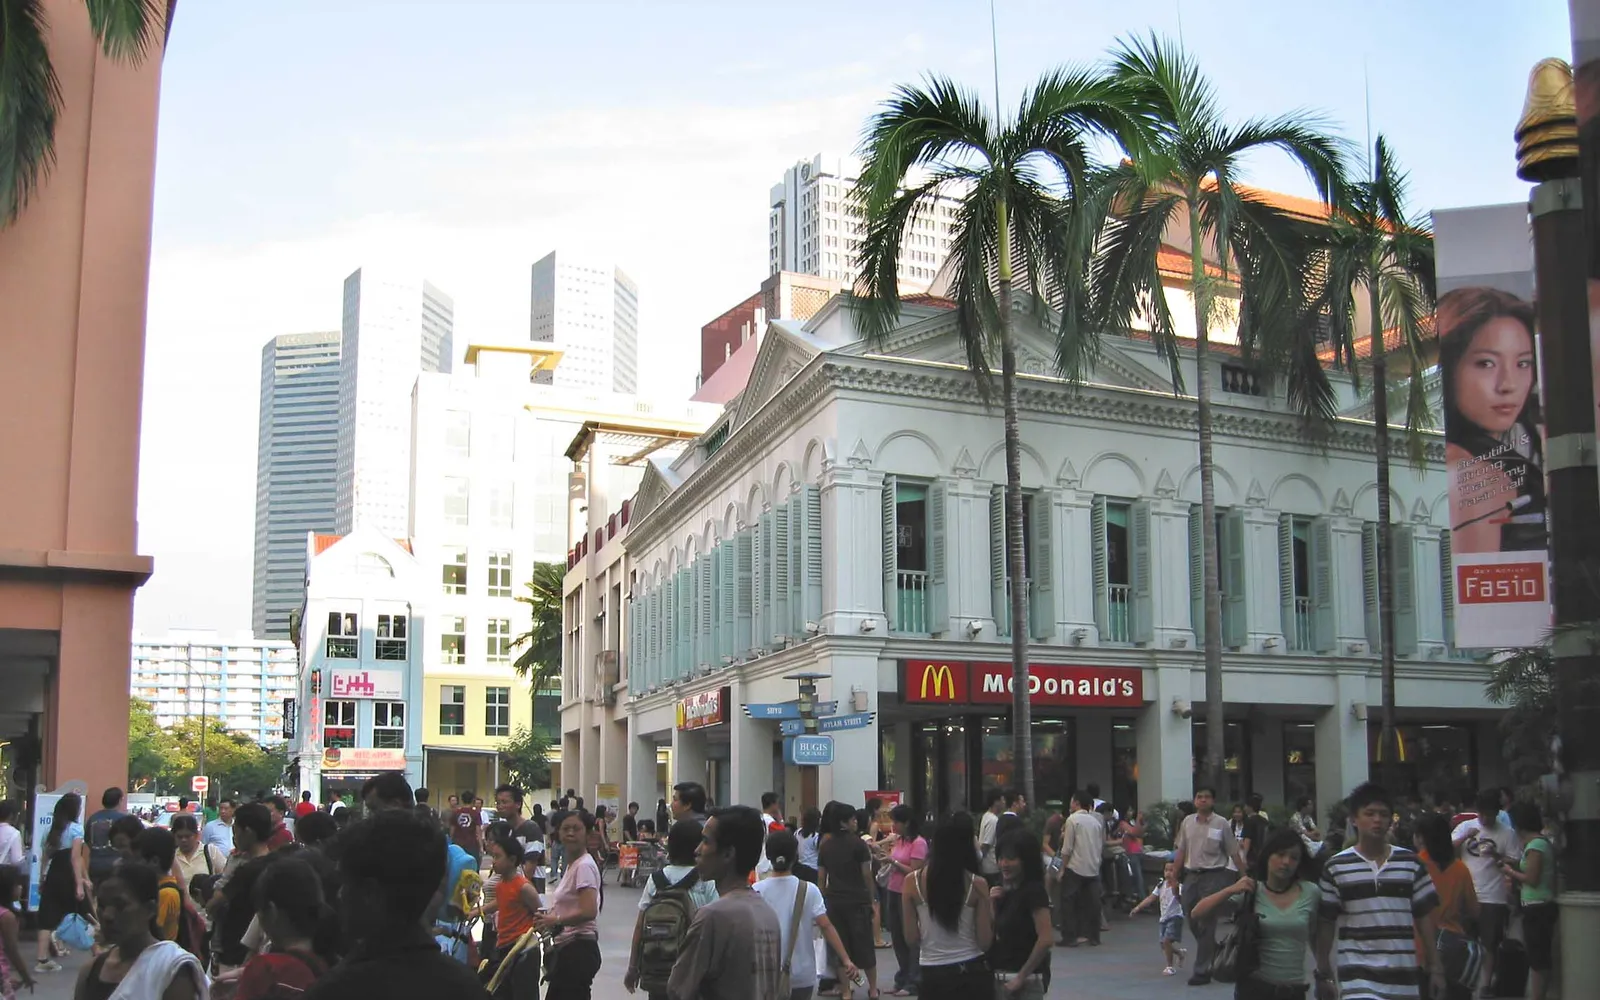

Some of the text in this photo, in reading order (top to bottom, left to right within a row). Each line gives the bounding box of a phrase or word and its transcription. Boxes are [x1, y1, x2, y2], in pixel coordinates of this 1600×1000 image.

[1456, 433, 1531, 471] Beautiful &
[1503, 463, 1526, 478] my
[1466, 575, 1536, 598] Fasio
[799, 742, 829, 751] BUGIS
